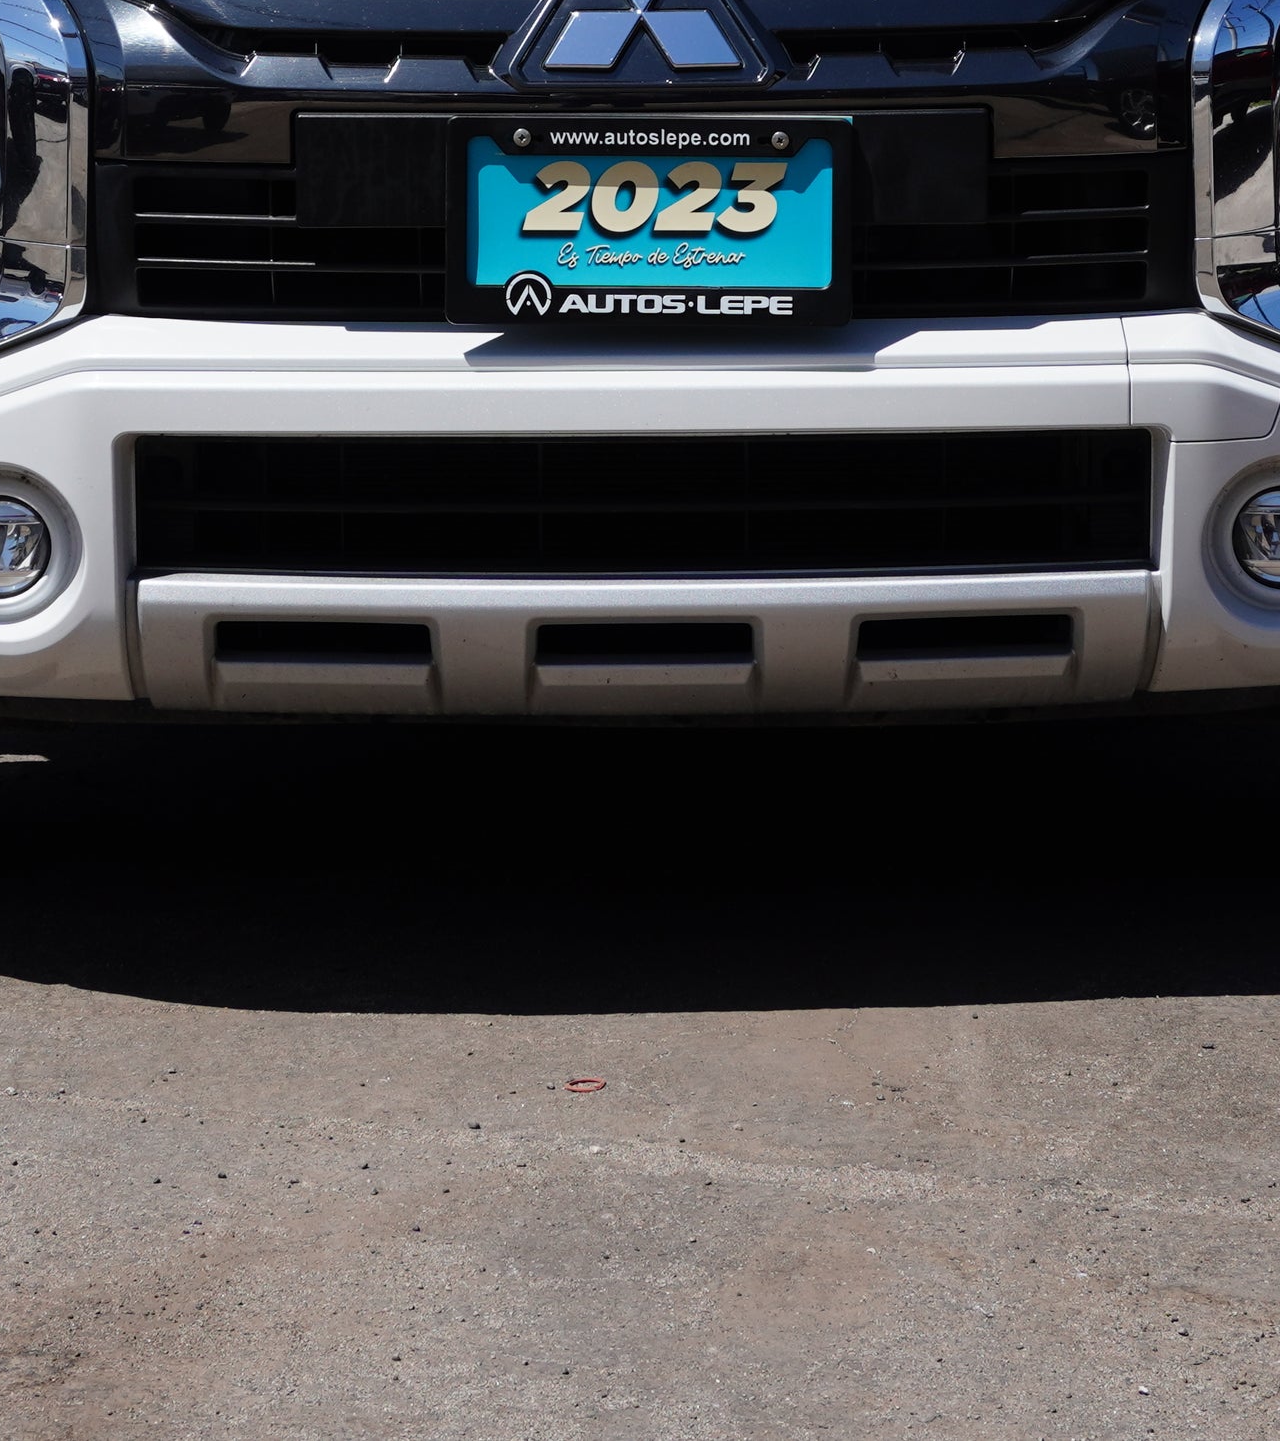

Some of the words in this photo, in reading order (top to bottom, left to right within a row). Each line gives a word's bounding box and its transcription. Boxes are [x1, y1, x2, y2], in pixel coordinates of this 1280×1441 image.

[549, 128, 751, 150] www.autoslepe.com
[521, 160, 788, 234] 2023
[556, 242, 580, 267] Es
[585, 244, 644, 269] Tiempo
[647, 247, 669, 265] de
[672, 242, 747, 267] Estrenar
